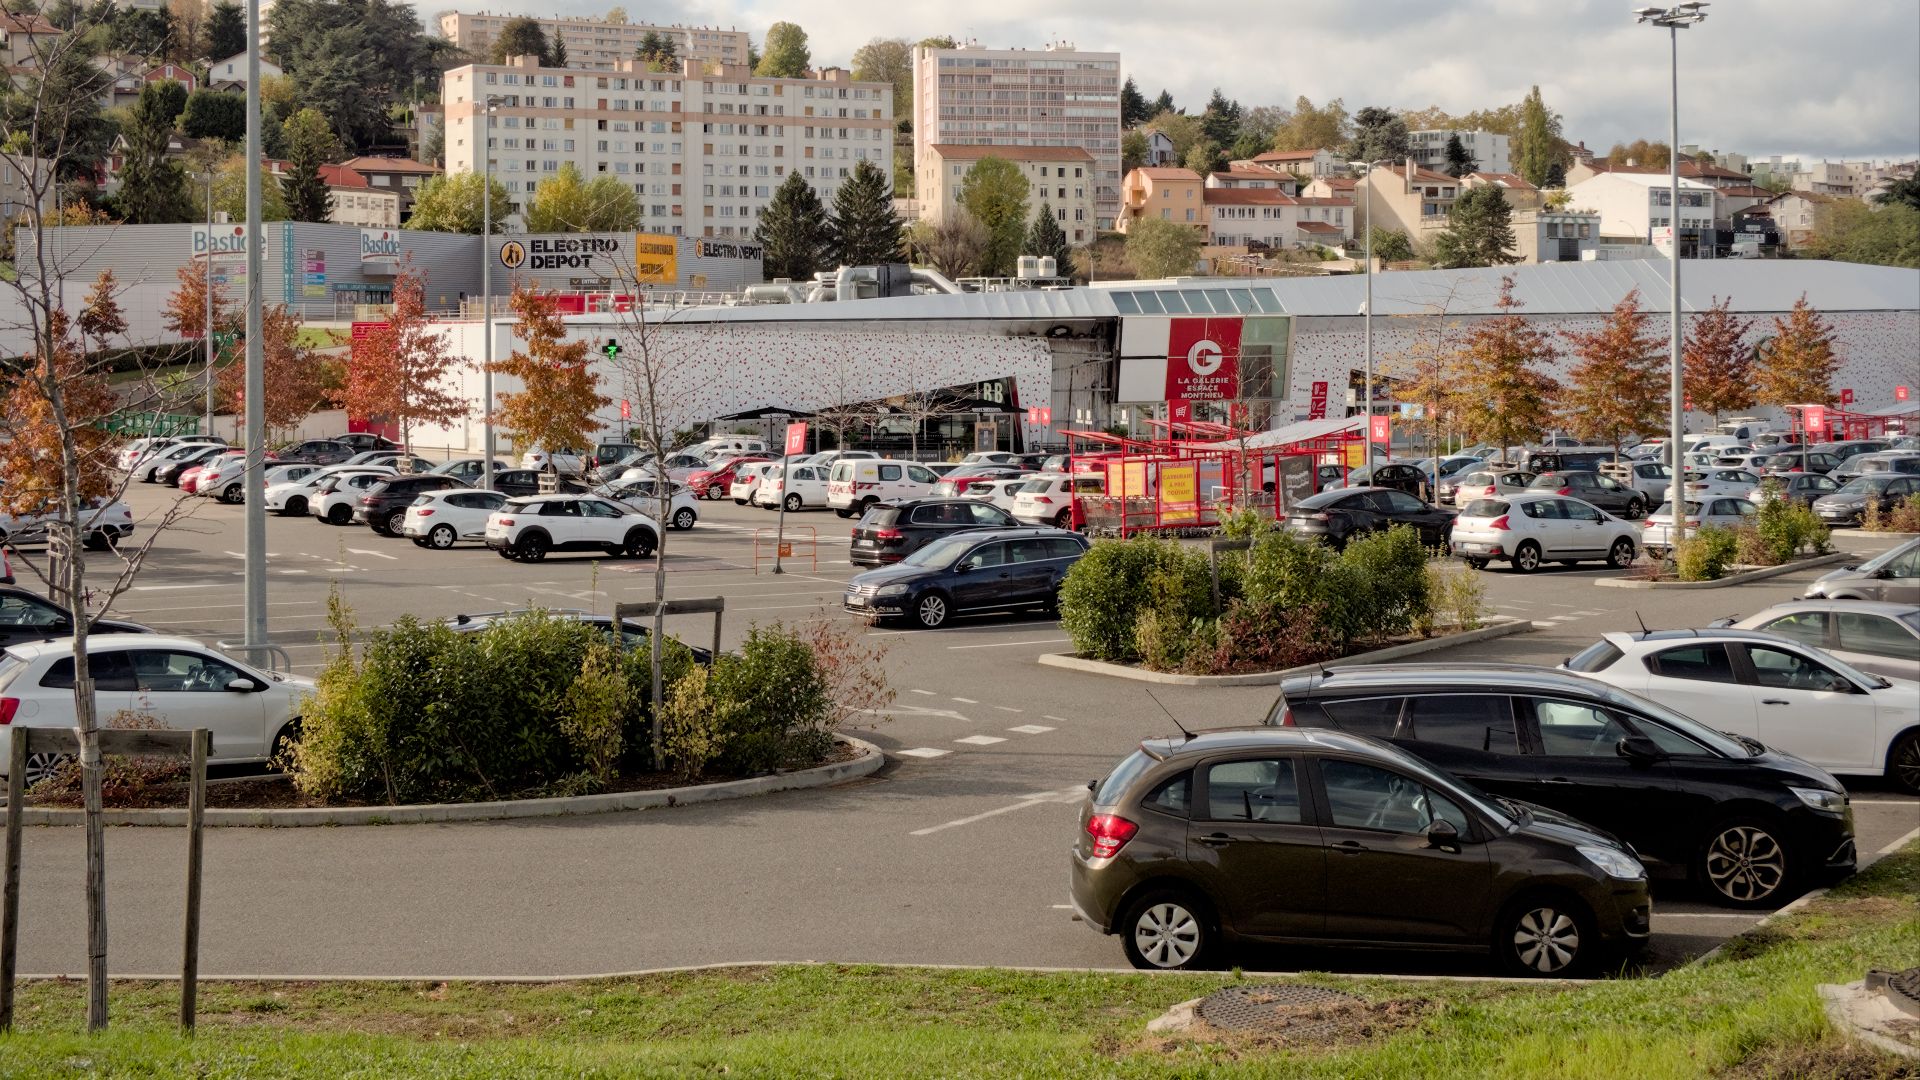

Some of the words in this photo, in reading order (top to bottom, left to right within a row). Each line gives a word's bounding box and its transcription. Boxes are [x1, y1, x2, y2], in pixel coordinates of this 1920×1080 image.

[194, 227, 266, 252] Bastie
[362, 232, 399, 254] Bastide
[531, 239, 618, 253] ELECTRO
[704, 242, 738, 259] ELECTRO
[739, 245, 762, 260] DEPOT
[531, 254, 592, 269] DEPOT
[1181, 391, 1224, 399] MONTHIEU
[1810, 417, 1819, 427] 15
[1375, 426, 1384, 438] 16
[792, 435, 801, 449] 17
